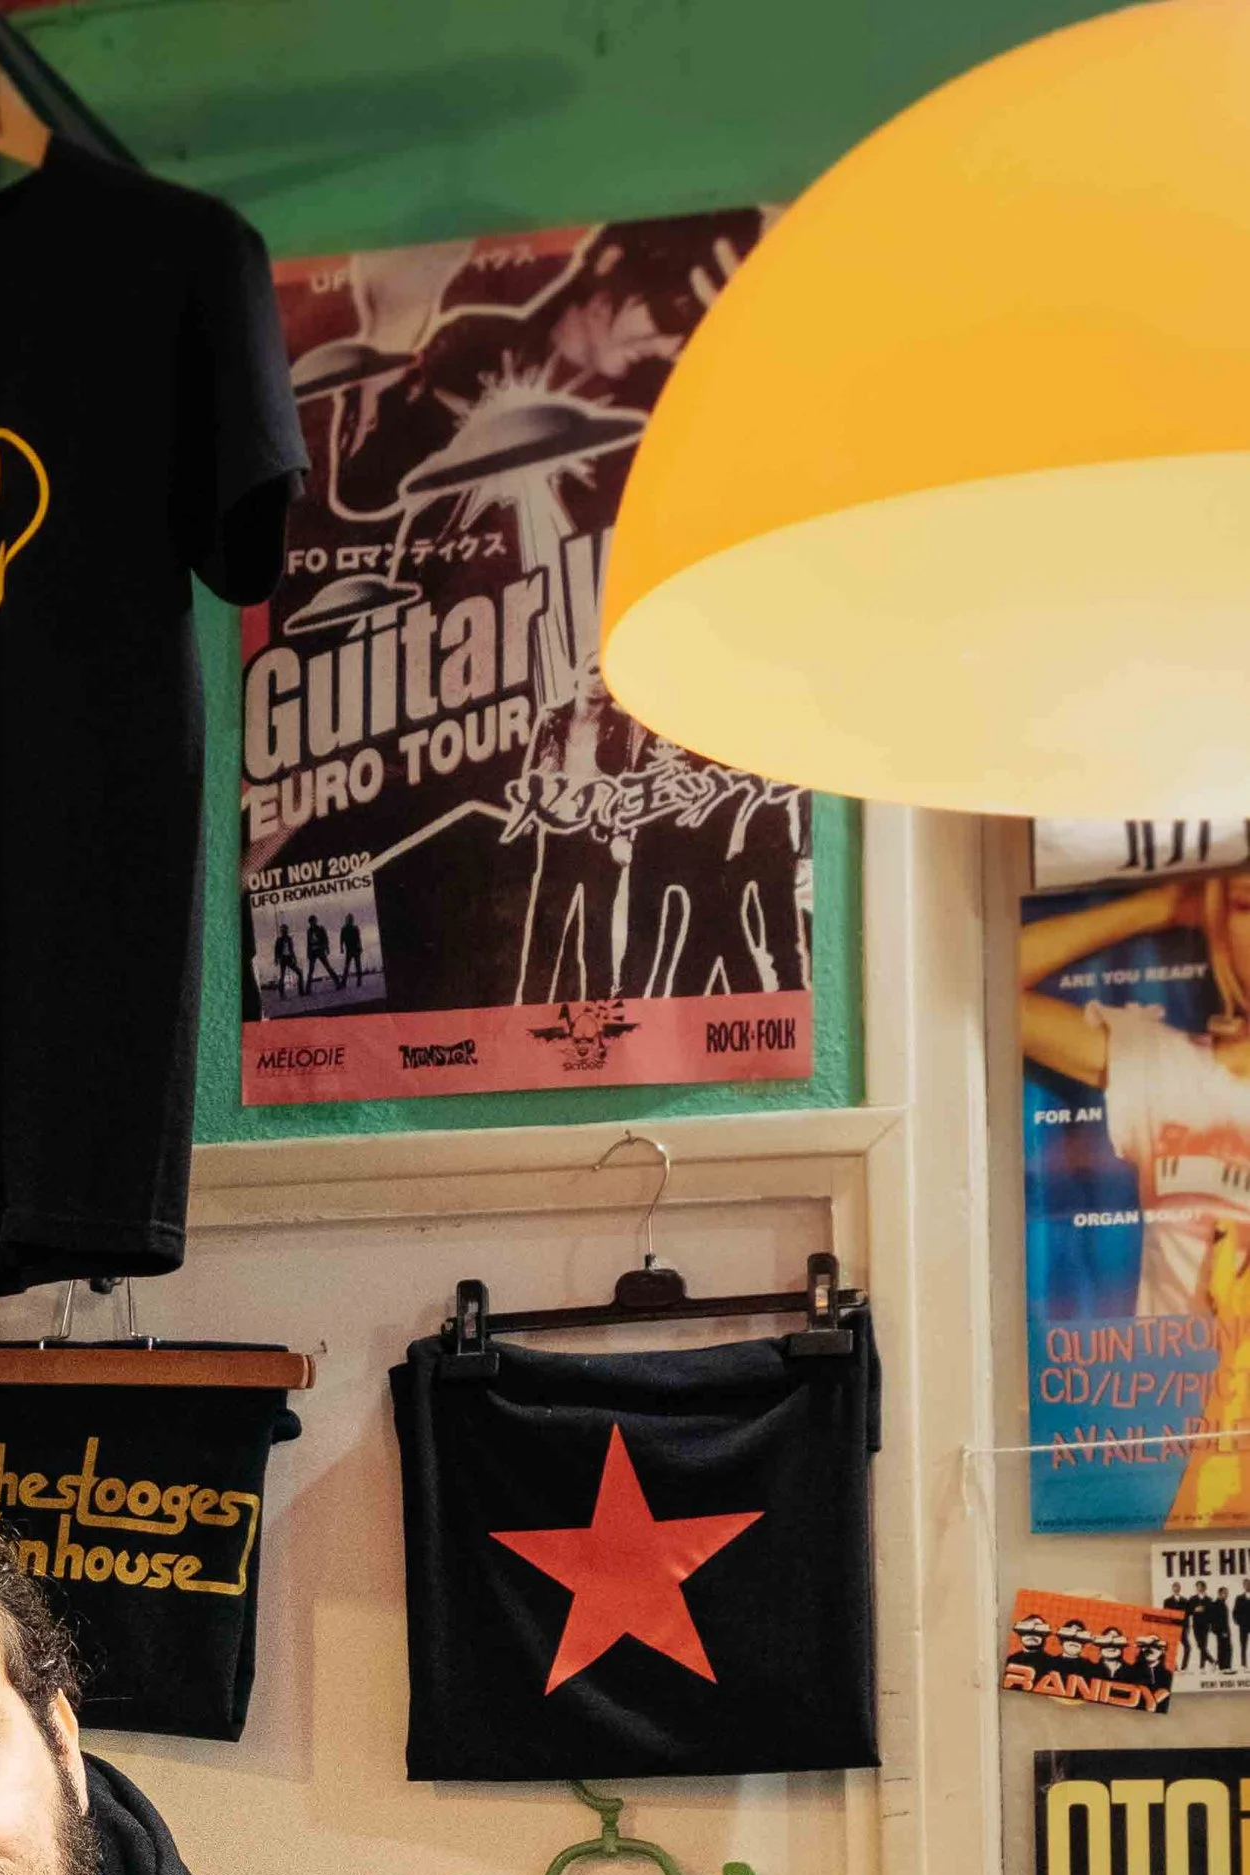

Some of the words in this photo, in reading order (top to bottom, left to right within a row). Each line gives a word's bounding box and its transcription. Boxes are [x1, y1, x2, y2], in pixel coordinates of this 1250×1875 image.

[244, 570, 544, 780] Guitar
[243, 747, 385, 842] EURO
[400, 694, 532, 787] TOUR
[249, 867, 283, 891] OUT
[287, 858, 324, 886] NOV
[327, 851, 372, 877] 2002
[251, 892, 280, 909] UFO
[282, 874, 373, 903] ROMANTICS
[1058, 973, 1097, 990] ARE
[1101, 969, 1140, 986] YOU
[1144, 963, 1208, 981] READY
[1033, 1108, 1071, 1126] FOR
[1074, 1106, 1102, 1123] AN
[1073, 1210, 1140, 1228] ORGAN
[54, 1436, 260, 1536] stooges
[53, 1515, 247, 1596] house
[1161, 1549, 1212, 1578] THE
[1002, 1662, 1171, 1713] RANDY
